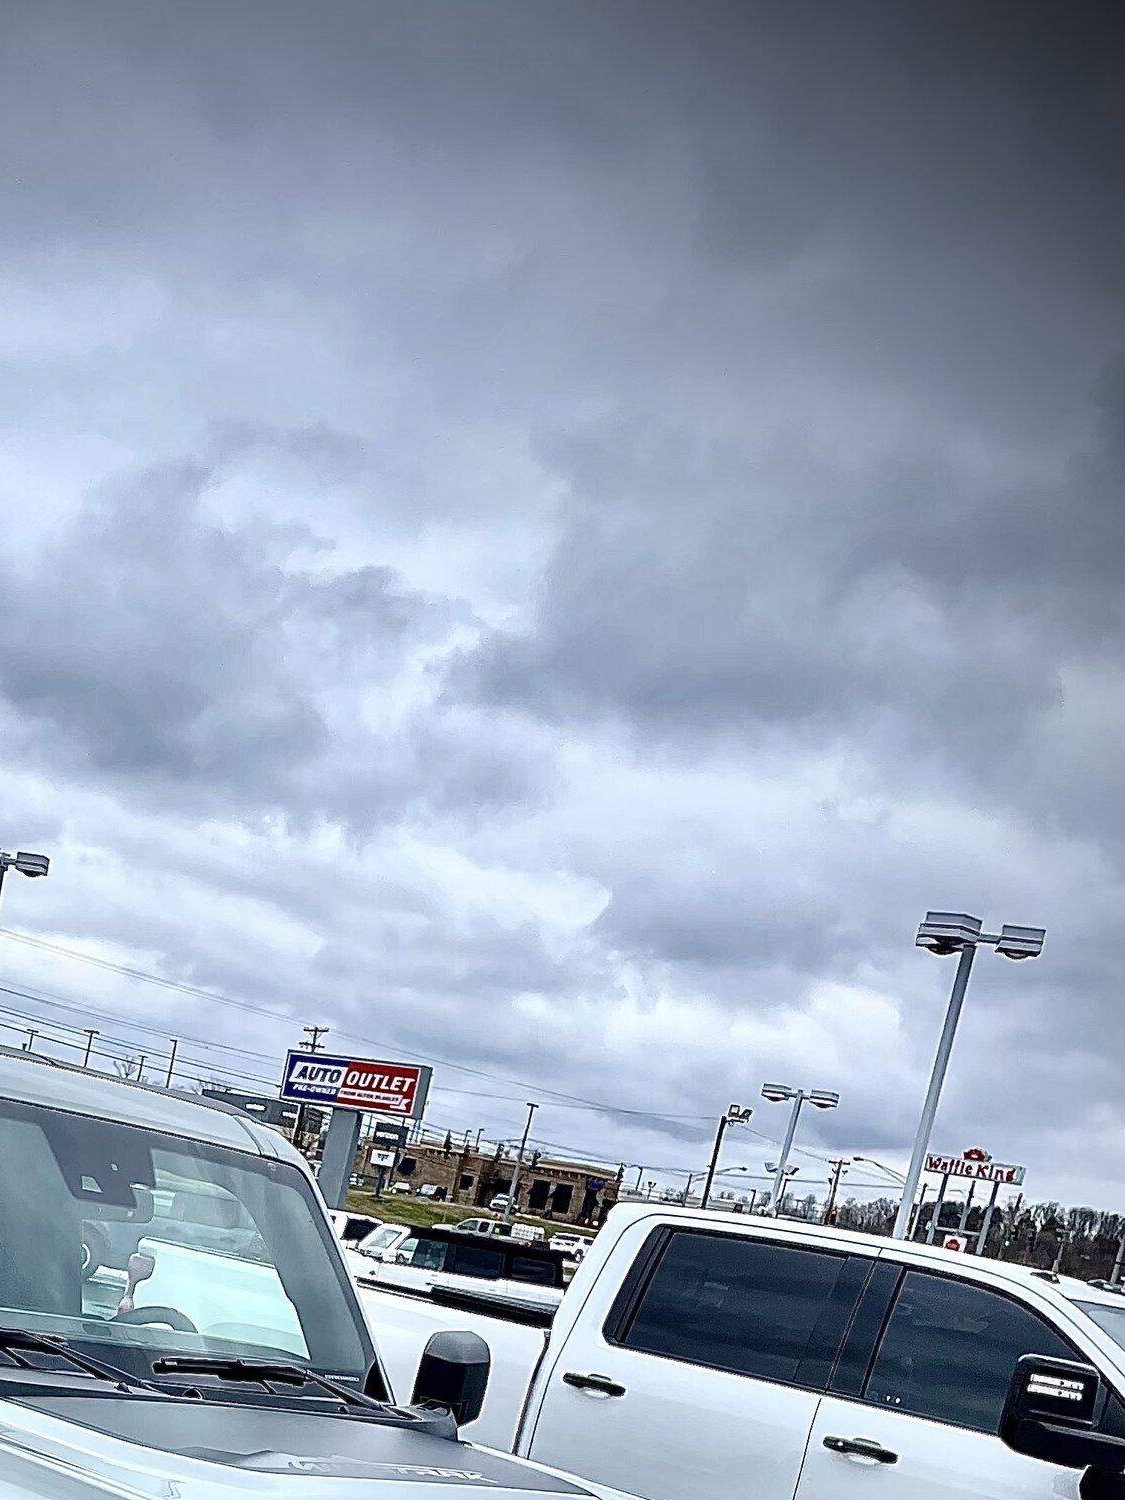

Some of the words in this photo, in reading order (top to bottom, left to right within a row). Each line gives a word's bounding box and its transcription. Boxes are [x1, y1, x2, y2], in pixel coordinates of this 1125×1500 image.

[295, 1064, 342, 1085] AUTO
[346, 1070, 416, 1092] OUTLET
[928, 1156, 973, 1176] Waffle
[976, 1163, 1017, 1182] King
